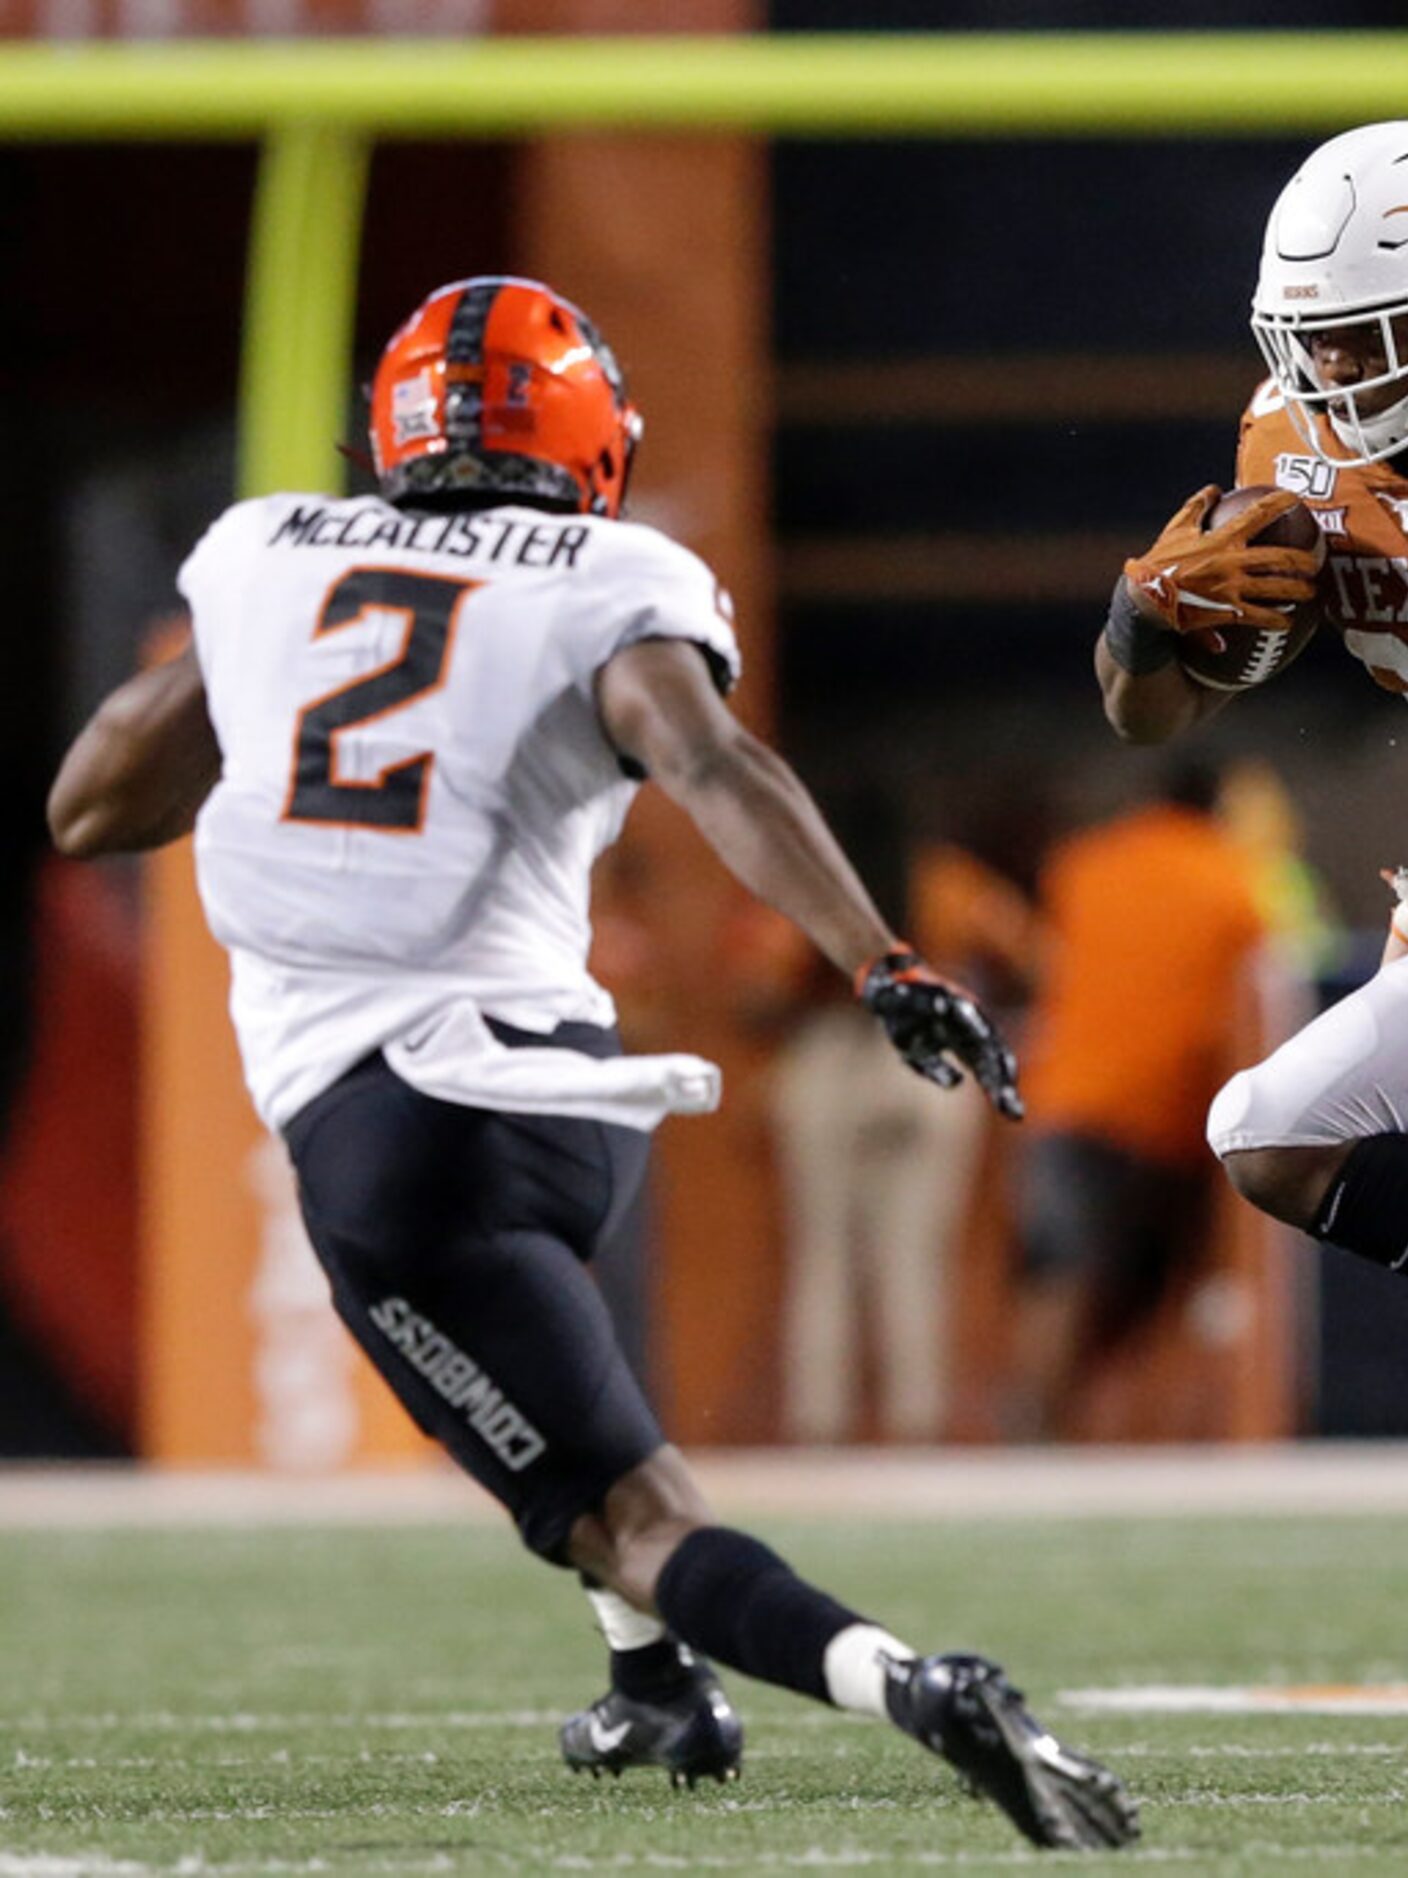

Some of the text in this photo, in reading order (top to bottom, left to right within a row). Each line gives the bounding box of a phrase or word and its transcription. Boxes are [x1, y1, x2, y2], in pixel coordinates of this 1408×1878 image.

[268, 504, 592, 571] McCALISTER
[280, 566, 490, 834] 2
[369, 1297, 547, 1471] COWBOYS
